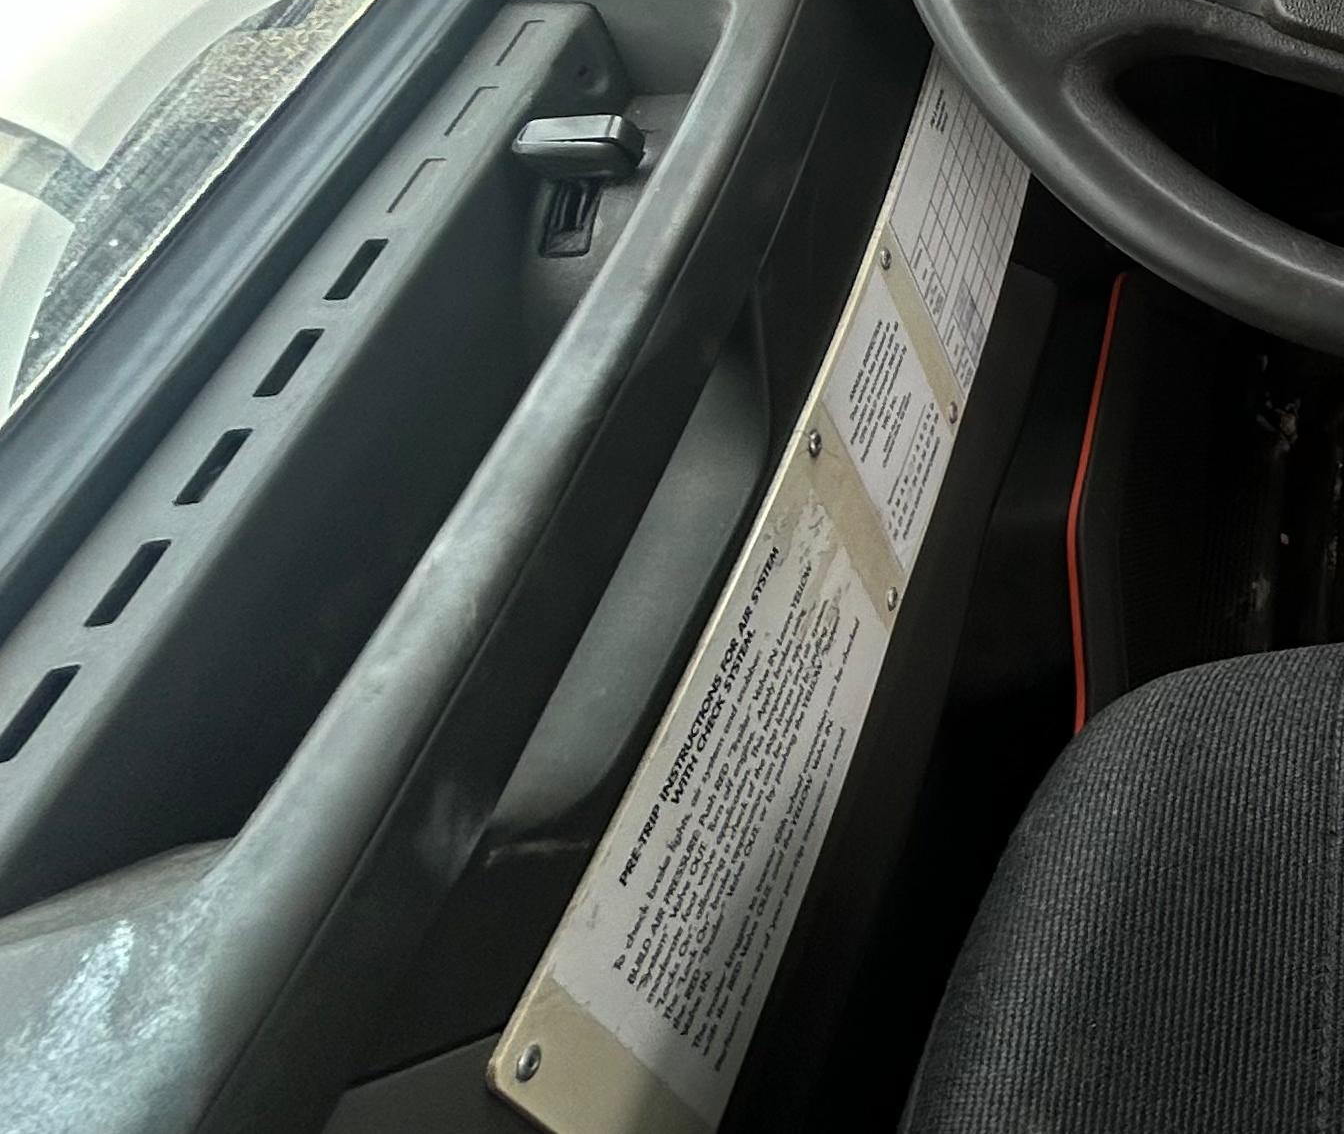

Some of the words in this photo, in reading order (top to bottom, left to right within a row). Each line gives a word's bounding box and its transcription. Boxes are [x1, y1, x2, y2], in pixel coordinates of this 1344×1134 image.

[618, 800, 662, 888] PRE-TRIP
[657, 669, 722, 806] INSTRUCTIONS
[719, 635, 739, 674] FOR
[735, 603, 753, 637] AIR
[749, 543, 780, 606] SYSTEM
[626, 935, 652, 986] BUILD
[648, 905, 665, 937] AIR
[698, 791, 716, 827] Push
[713, 760, 729, 792] RED
[789, 559, 814, 611] YELLOW
[670, 752, 698, 807] WITH
[694, 691, 726, 755] CHECK
[722, 623, 756, 694] SYSTEM.
[612, 950, 626, 972] To
[622, 900, 649, 951] check
[645, 850, 671, 901] brake
[669, 877, 690, 922] Valve
[720, 777, 734, 801] off
